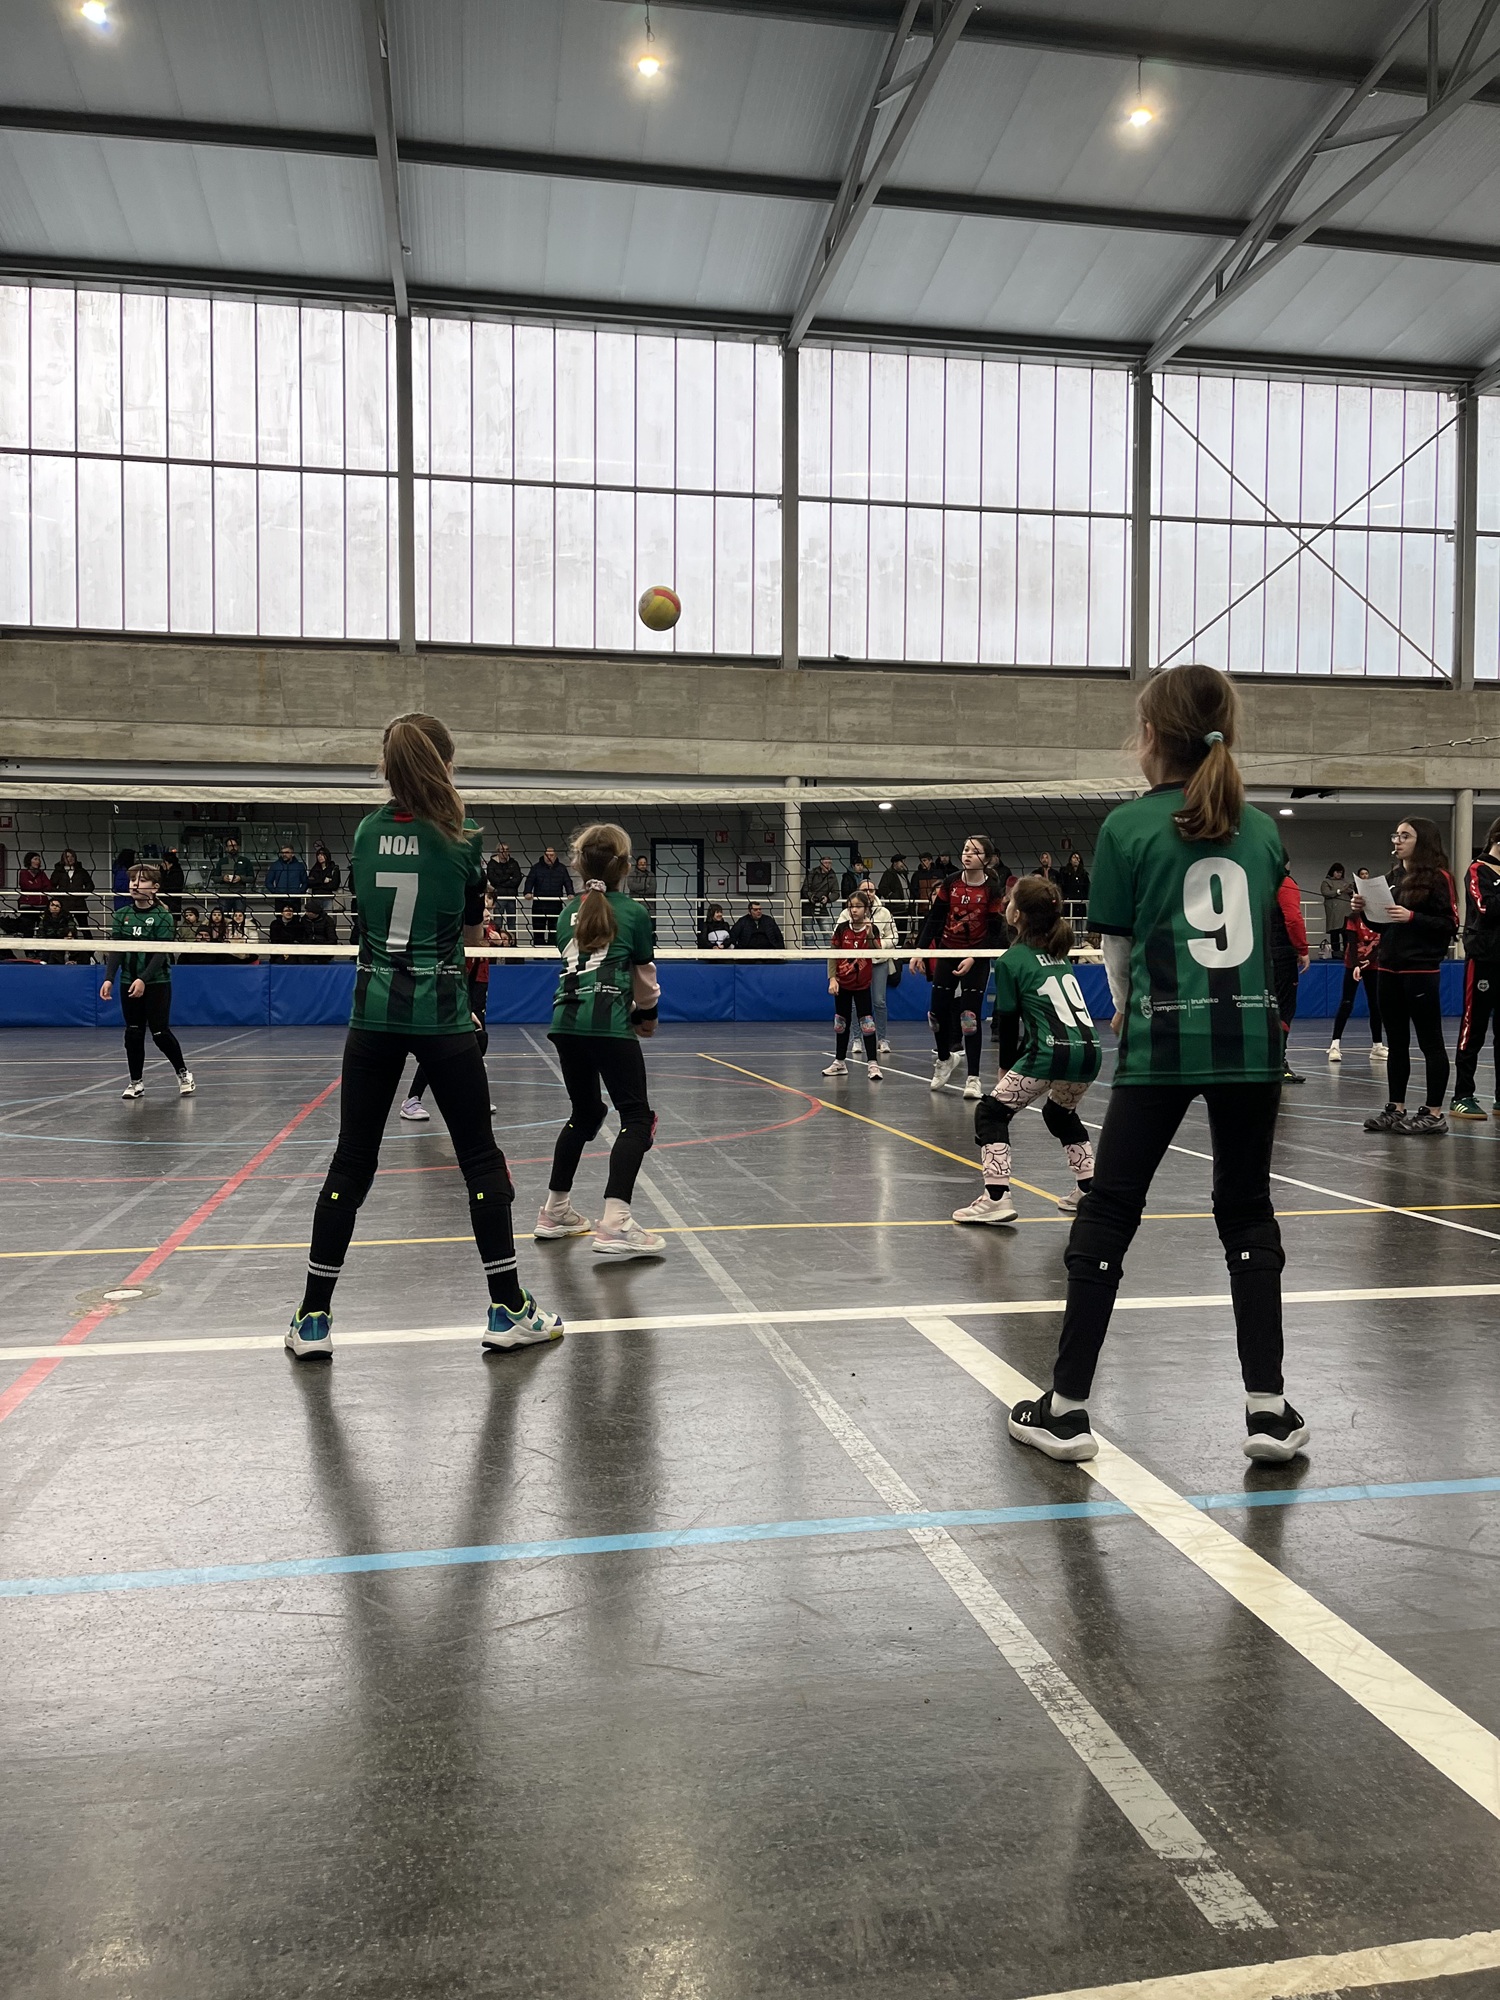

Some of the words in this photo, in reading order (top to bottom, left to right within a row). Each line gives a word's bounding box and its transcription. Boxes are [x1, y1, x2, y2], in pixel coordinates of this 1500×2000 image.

[378, 835, 420, 856] NOA
[132, 926, 143, 937] 14
[375, 871, 419, 953] 7
[1183, 857, 1254, 969] 9
[1036, 973, 1095, 1028] 19
